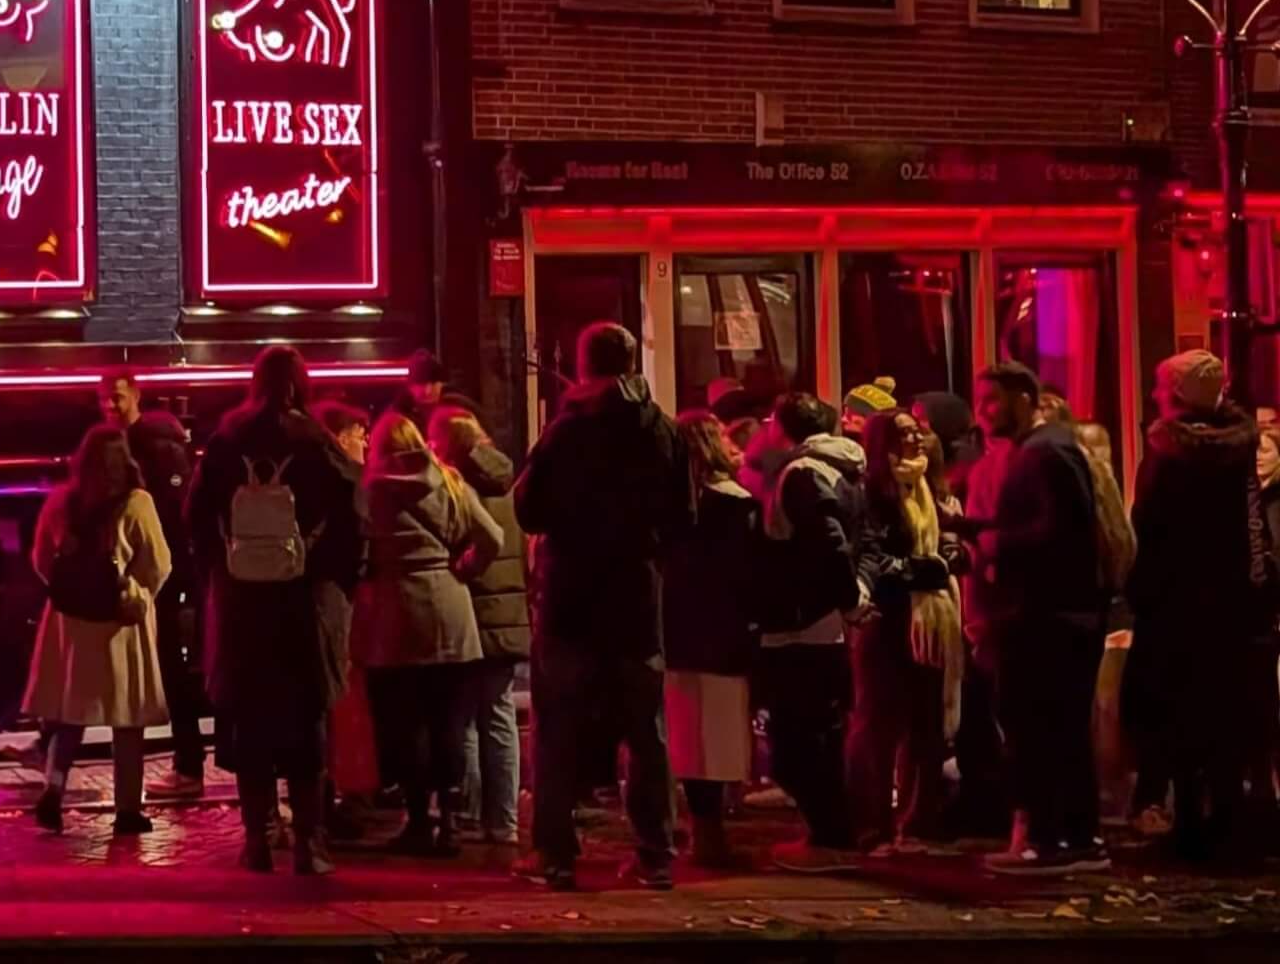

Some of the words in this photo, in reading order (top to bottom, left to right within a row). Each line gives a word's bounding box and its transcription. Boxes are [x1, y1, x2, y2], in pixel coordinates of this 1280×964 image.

[211, 100, 294, 144] LIVE
[301, 102, 363, 147] SEX
[745, 161, 774, 180] The
[778, 161, 825, 180] Office
[830, 162, 849, 180] 52
[226, 173, 353, 229] theater
[656, 261, 668, 278] 9
